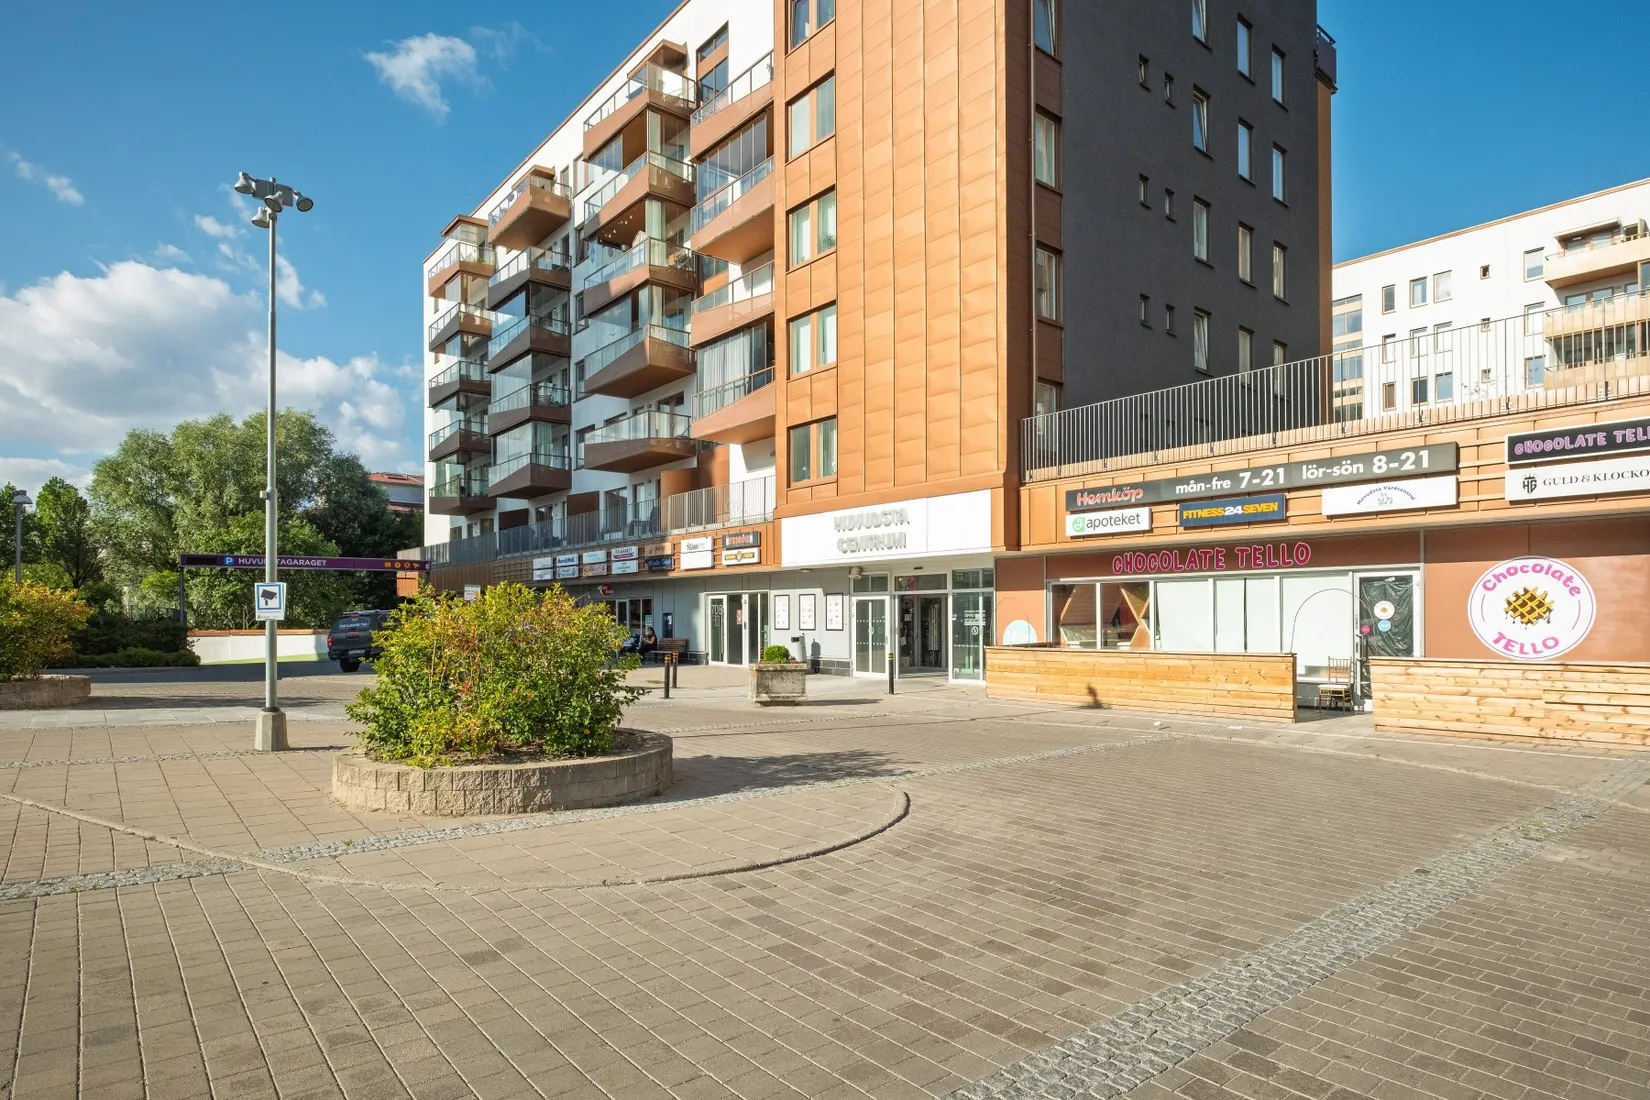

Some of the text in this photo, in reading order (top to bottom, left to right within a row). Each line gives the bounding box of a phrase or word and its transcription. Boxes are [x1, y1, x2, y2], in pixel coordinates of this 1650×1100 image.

[1514, 432, 1607, 455] CHOCOLATE
[1175, 449, 1429, 494] mån-fre 7-21 lör-sön 8-21
[1543, 475, 1579, 487] GULD
[1581, 473, 1591, 483] &
[1076, 486, 1144, 506] Hemköp
[834, 508, 910, 532] HUVUDSTA
[1086, 512, 1141, 530] apoteket
[837, 532, 907, 554] CENTRUM
[238, 557, 327, 566] HUVUTAGARAGET
[1112, 542, 1311, 574] CHOCOLATE TELLO
[1482, 563, 1581, 597] Chocolate
[1493, 631, 1559, 655] TELLO
